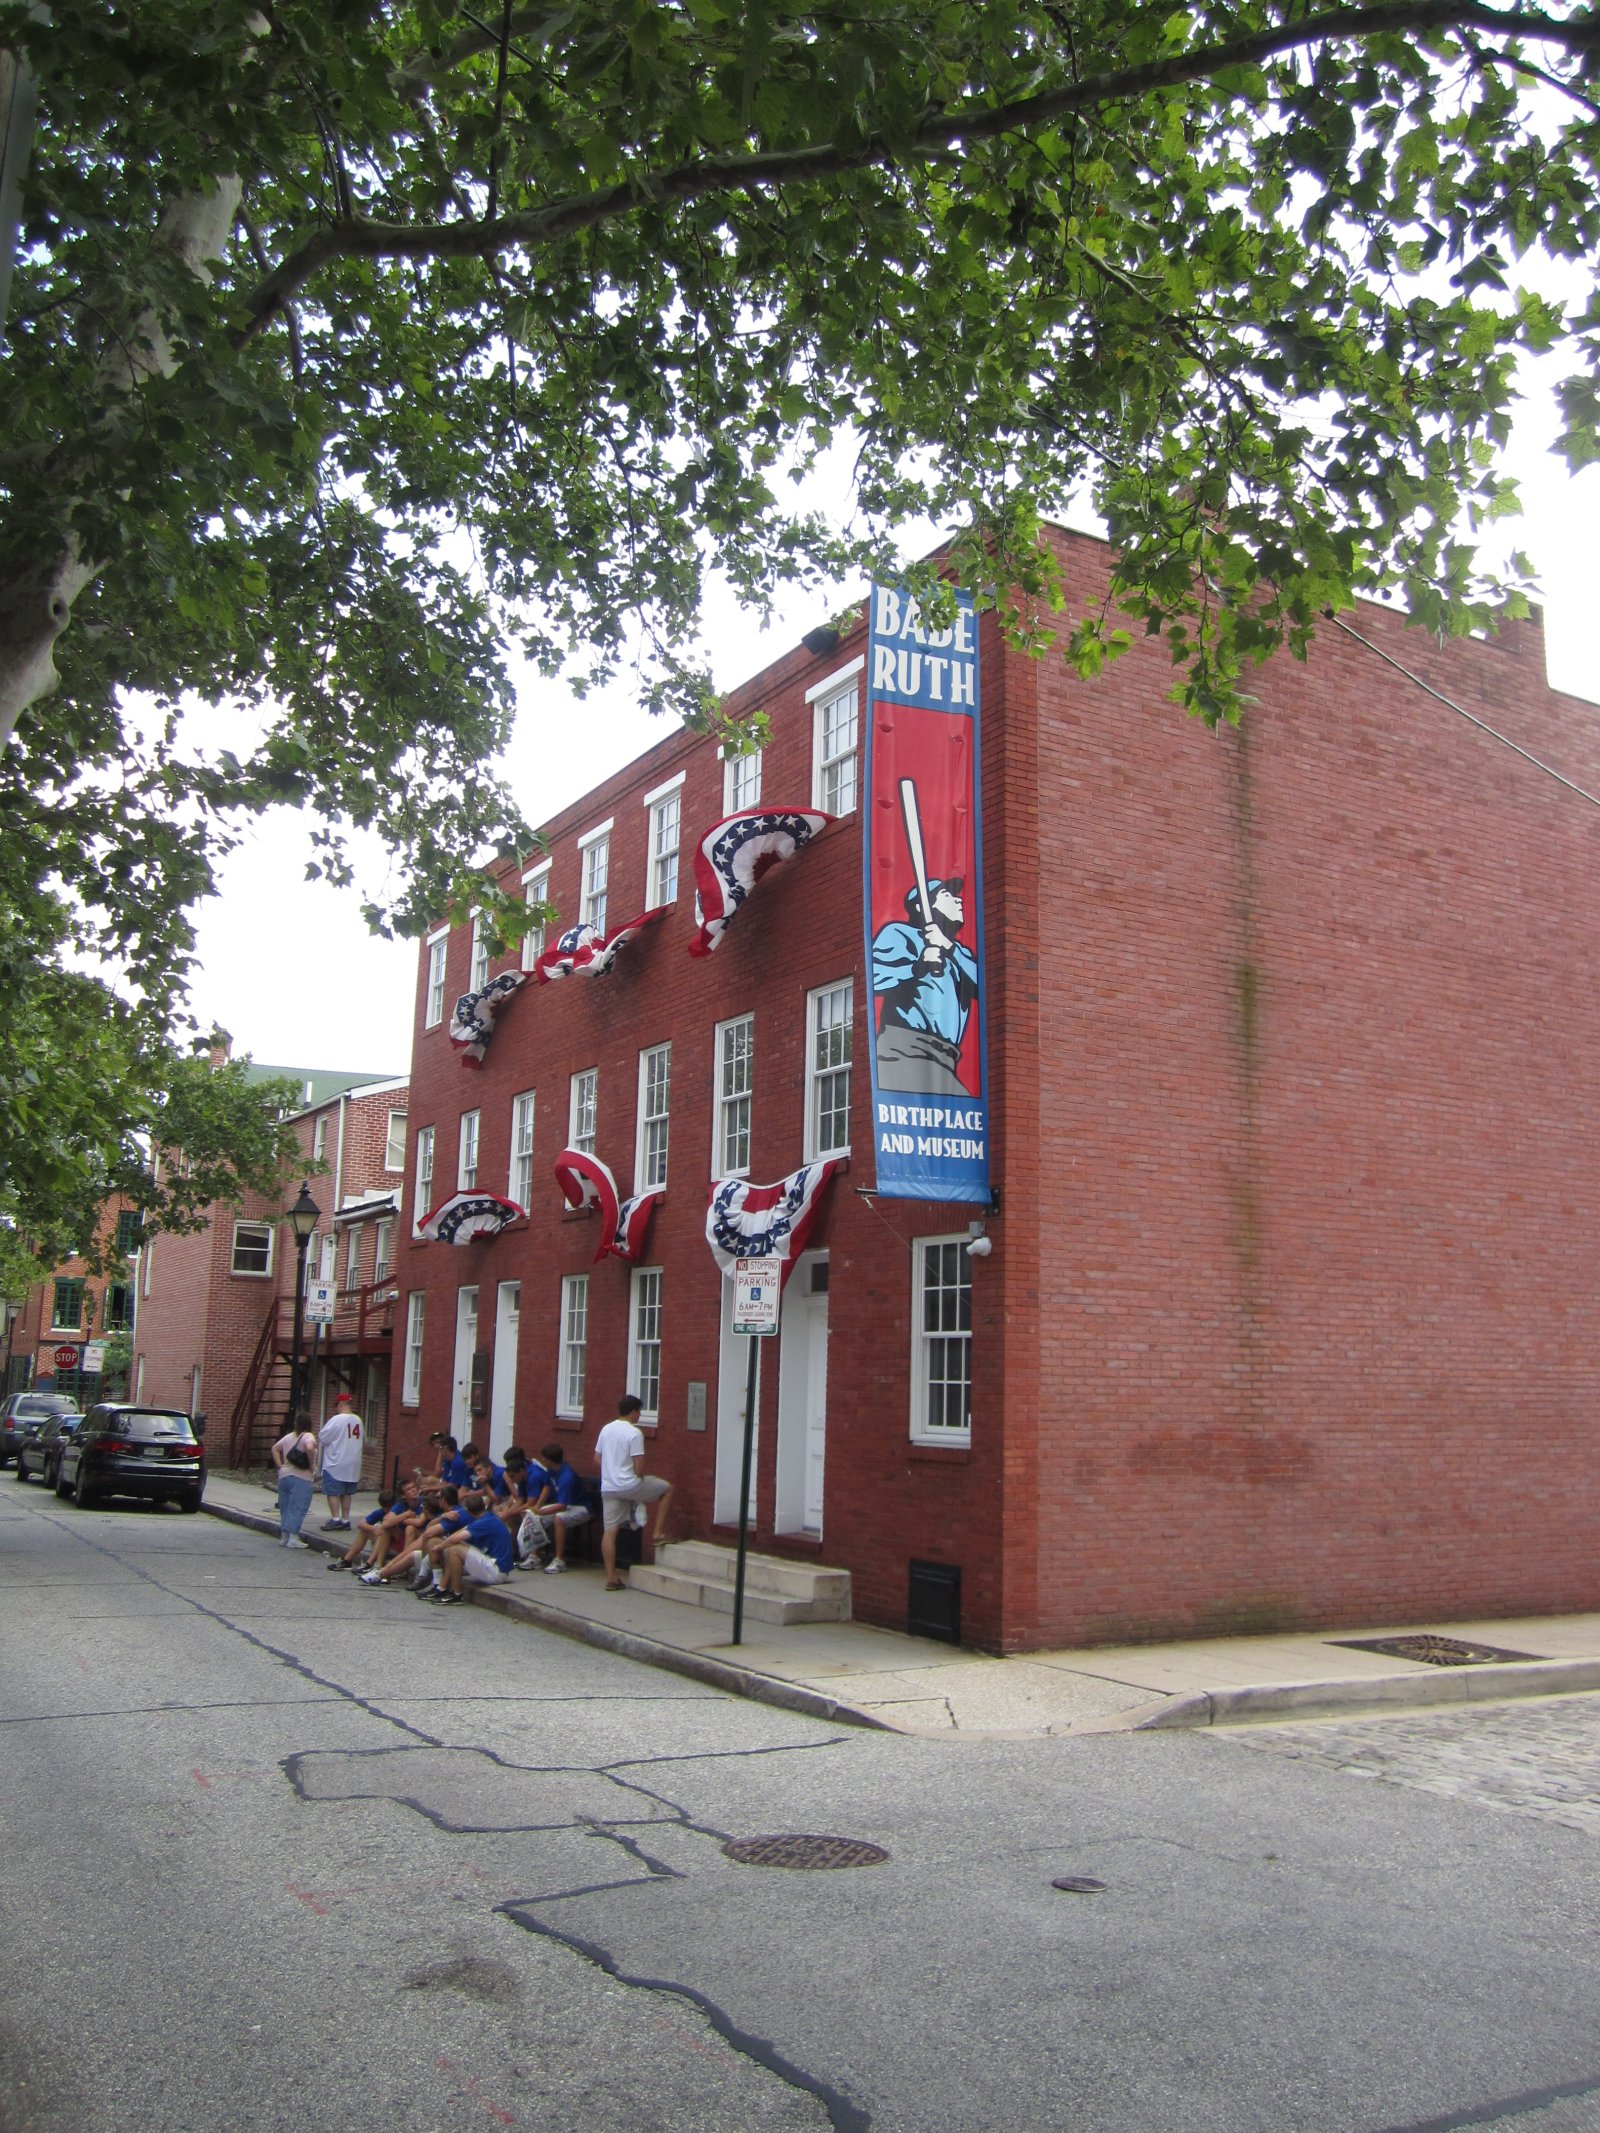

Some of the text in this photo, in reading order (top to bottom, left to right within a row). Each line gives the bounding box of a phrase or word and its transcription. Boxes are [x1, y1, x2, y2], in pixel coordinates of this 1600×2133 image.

[873, 644, 975, 706] RUTH
[878, 1104, 983, 1131] BIRTHPLACE
[881, 1133, 984, 1160] AND MUSEUM
[738, 1261, 778, 1270] NO STOPPING
[738, 1278, 776, 1287] PARKING
[55, 1352, 78, 1362] STOP
[347, 1423, 360, 1440] 14
